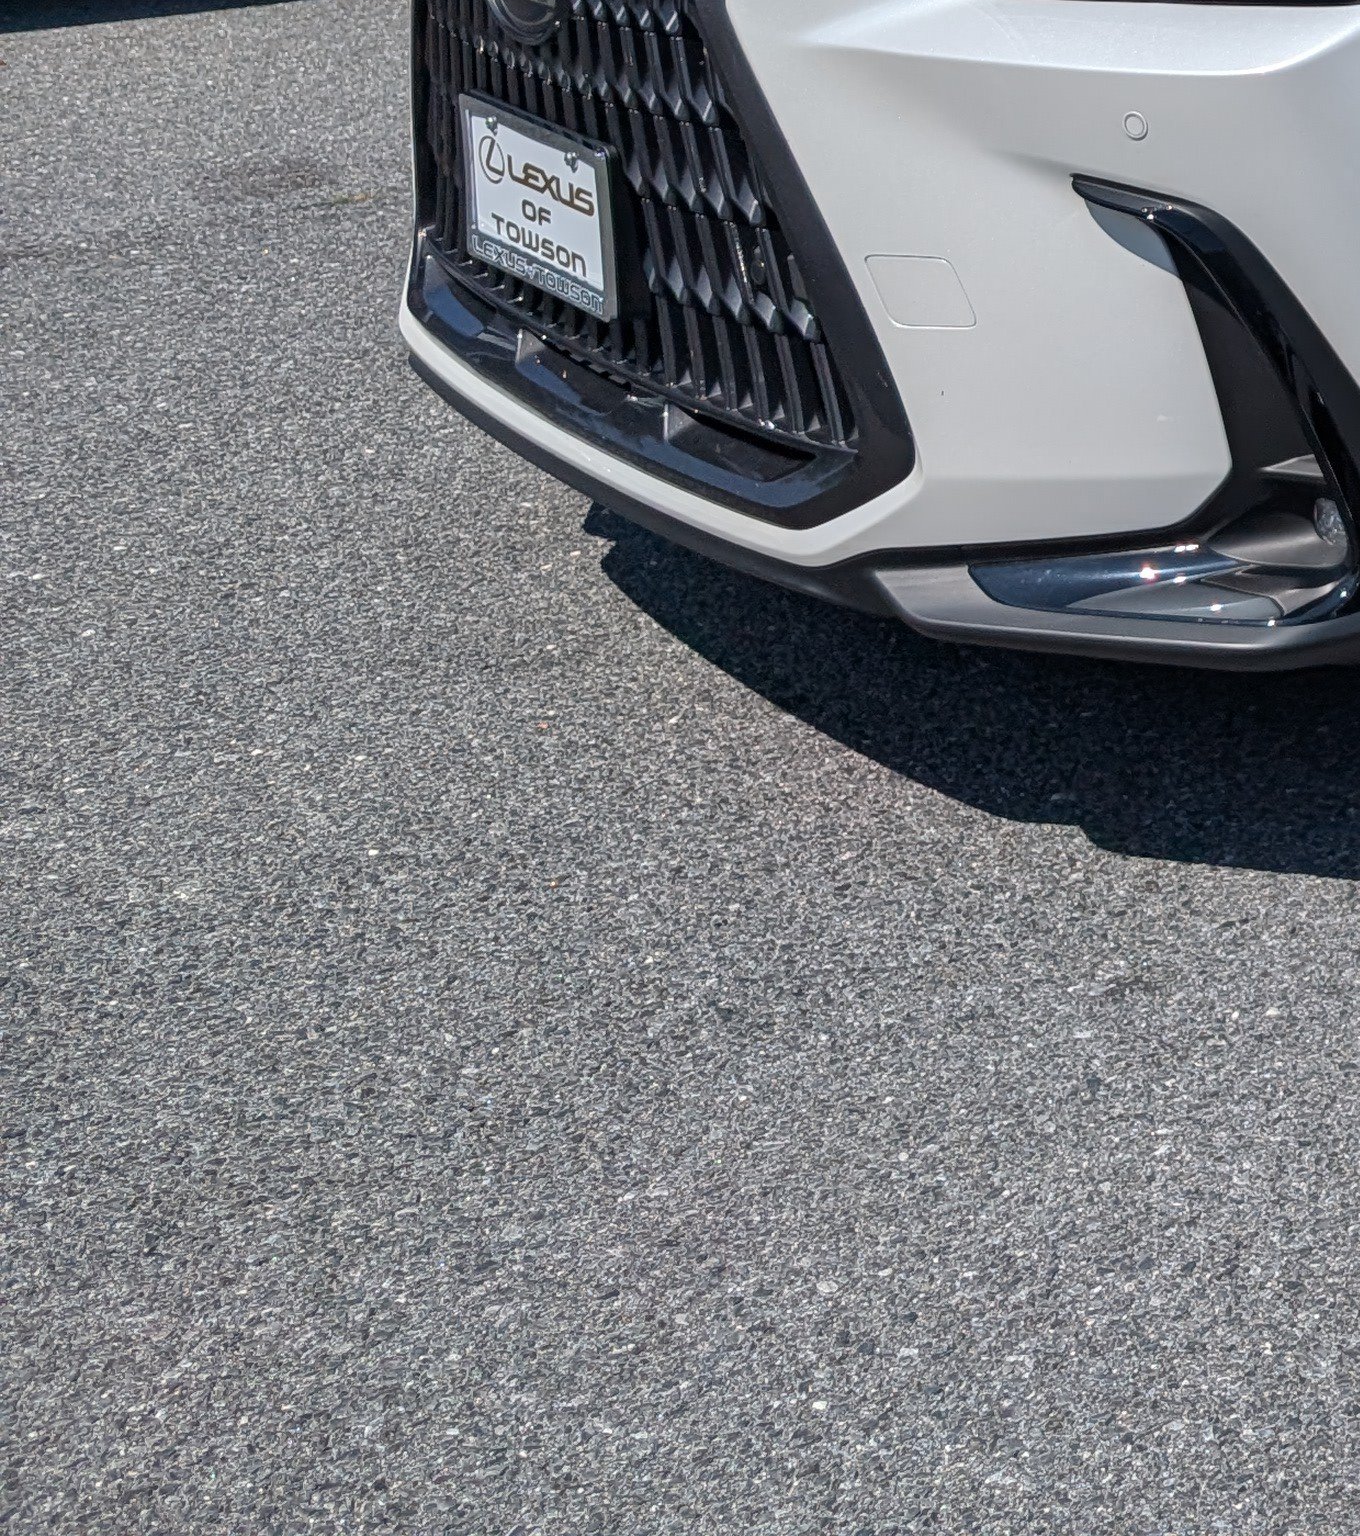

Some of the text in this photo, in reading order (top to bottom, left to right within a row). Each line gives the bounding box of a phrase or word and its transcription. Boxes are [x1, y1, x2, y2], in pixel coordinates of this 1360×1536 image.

[507, 153, 595, 217] LEXUS
[521, 198, 552, 226] OF
[472, 234, 527, 277] LEXUS
[491, 212, 587, 278] TOWSON
